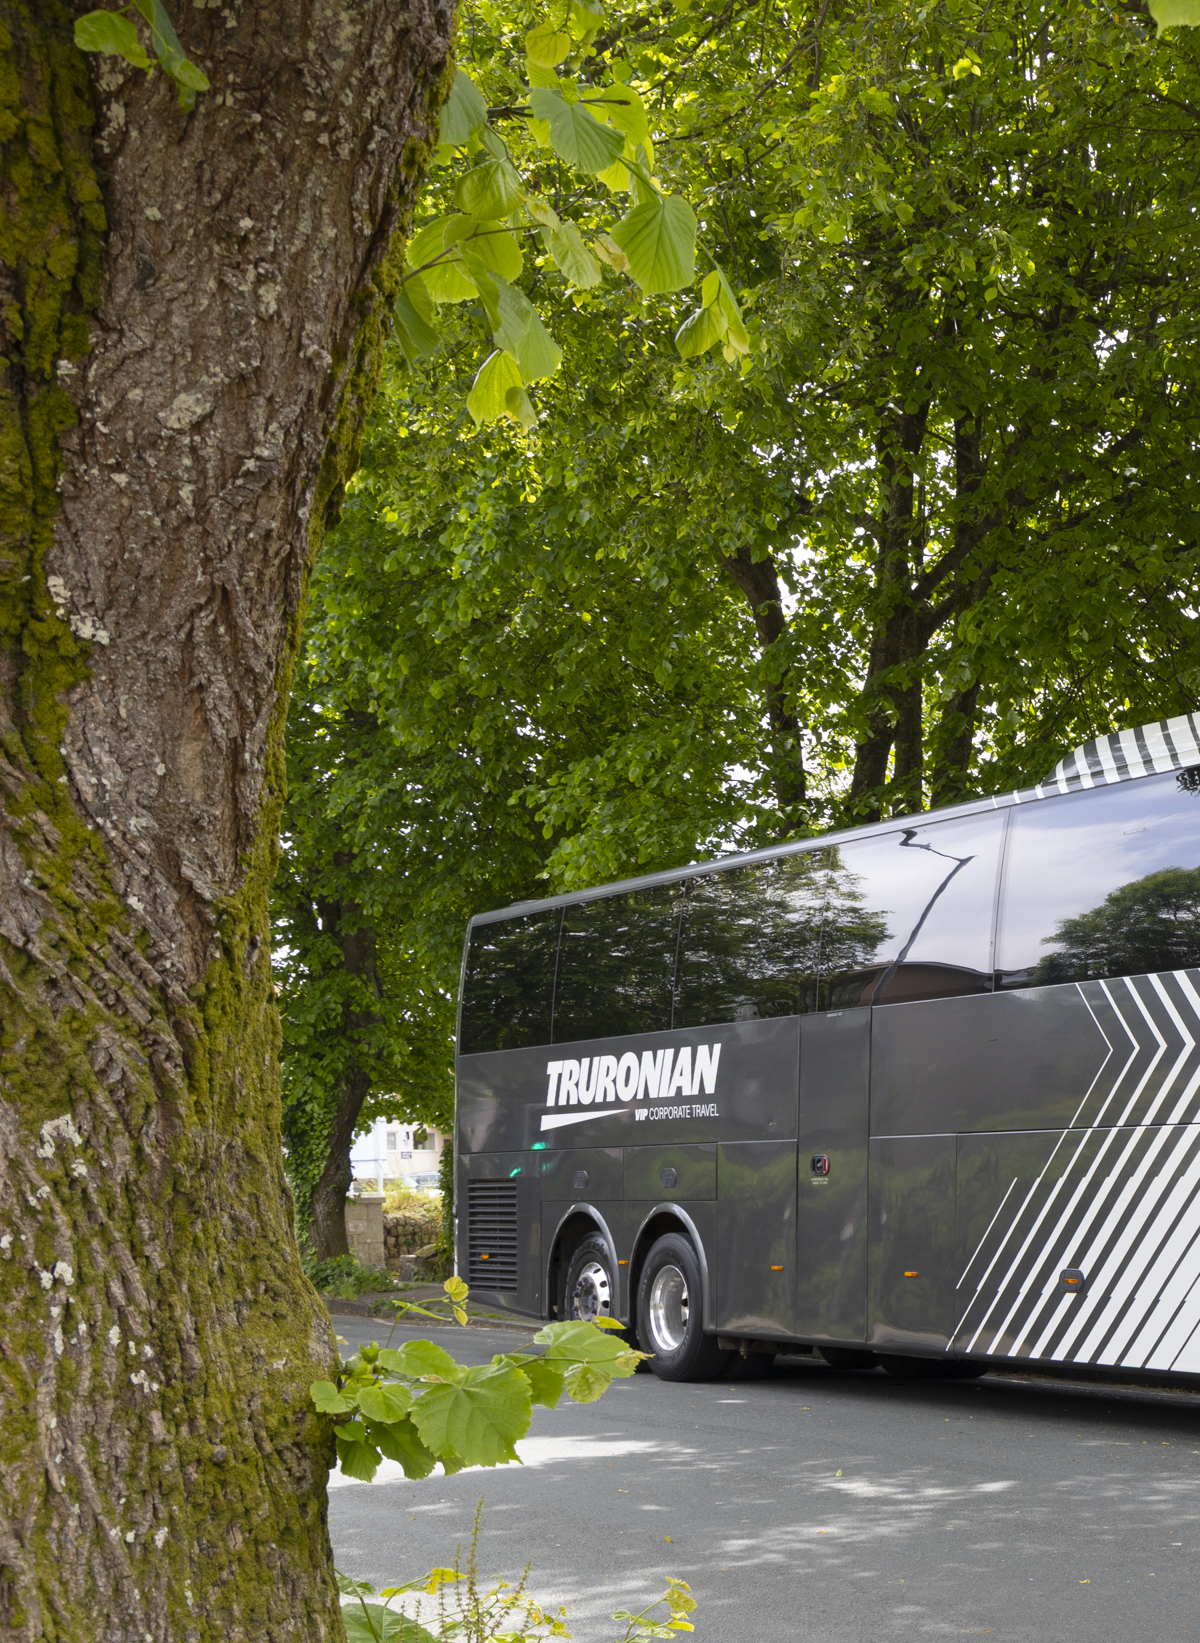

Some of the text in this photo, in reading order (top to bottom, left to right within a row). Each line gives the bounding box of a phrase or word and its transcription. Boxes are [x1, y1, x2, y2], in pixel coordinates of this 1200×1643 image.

[546, 1043, 722, 1107] TRURONIAN
[634, 1103, 720, 1121] VIP CORPORATE TRAVEL
